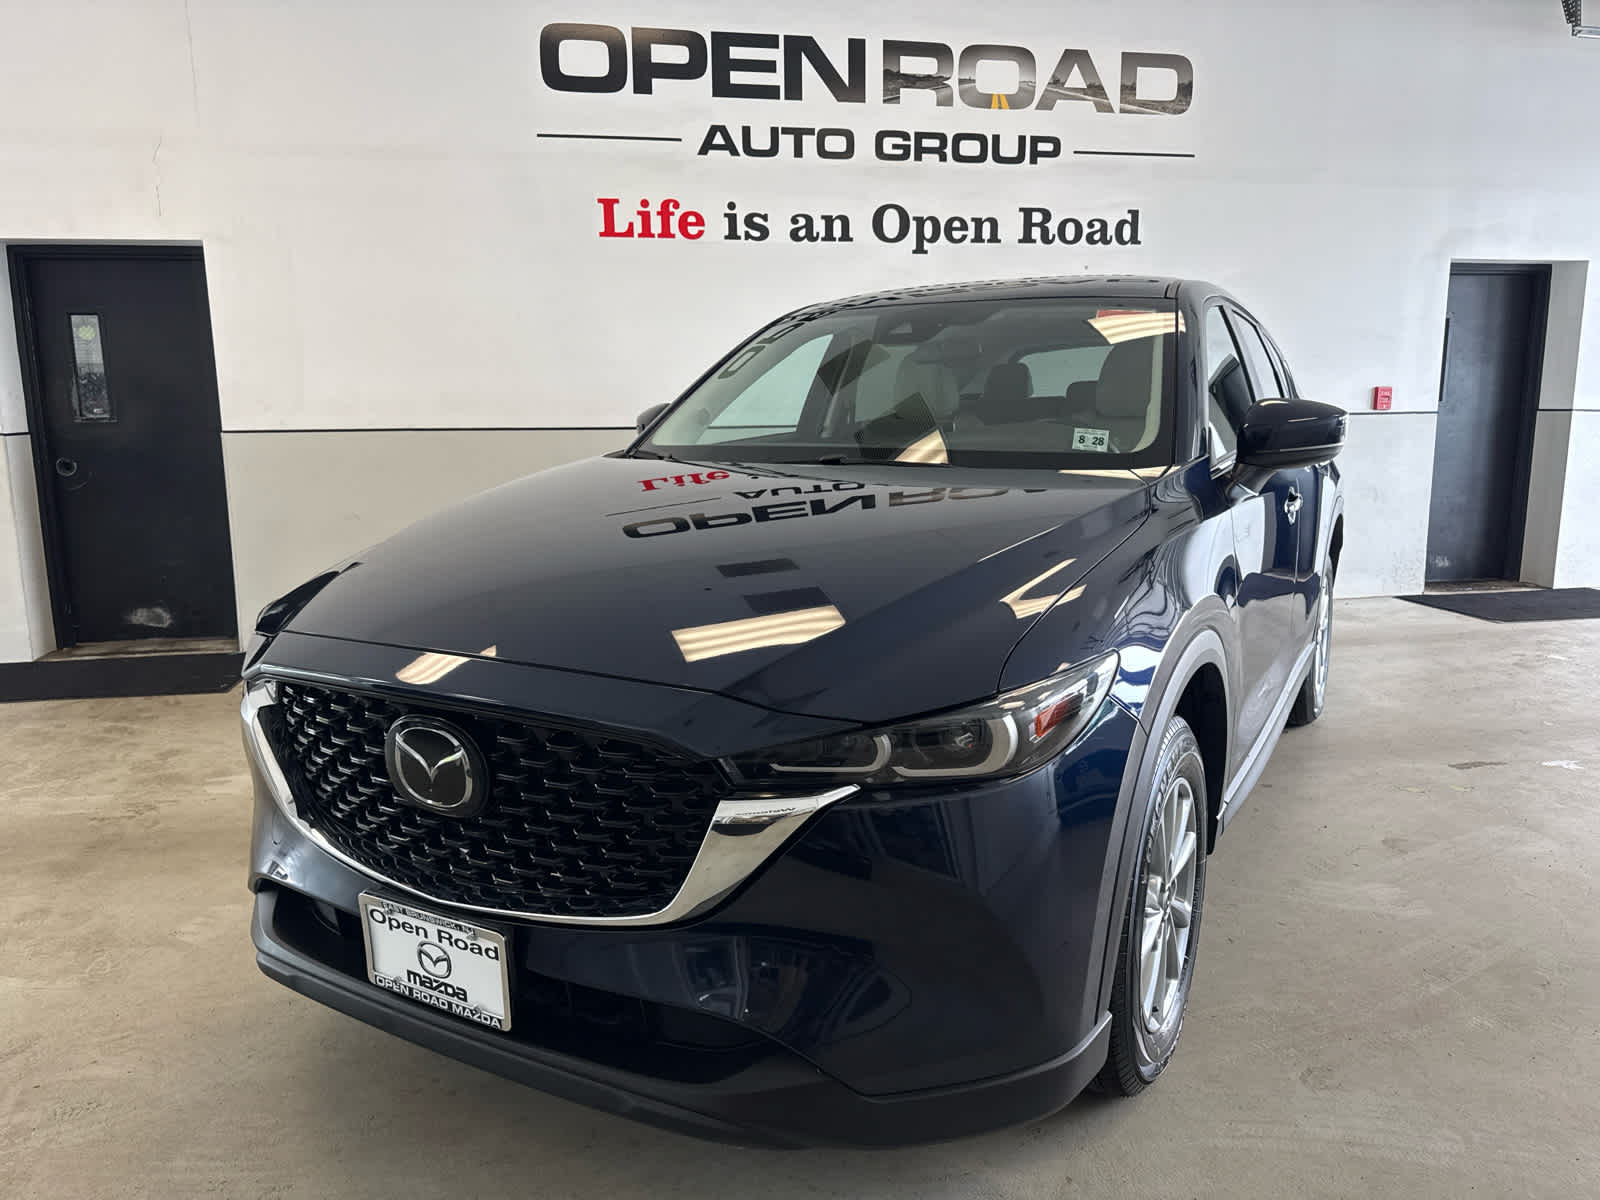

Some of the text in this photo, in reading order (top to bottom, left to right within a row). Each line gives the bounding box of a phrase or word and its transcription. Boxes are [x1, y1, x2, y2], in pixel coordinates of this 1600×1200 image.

[540, 23, 1193, 115] OPEN ROAD
[698, 125, 1061, 164] AUTO GROUP
[597, 198, 1141, 255] Life is an Open Road
[1078, 435, 1105, 446] 8 28
[369, 908, 500, 961] Open Road
[375, 975, 502, 1029] OPEN ROAD MAZDA
[407, 969, 468, 1002] mazda
